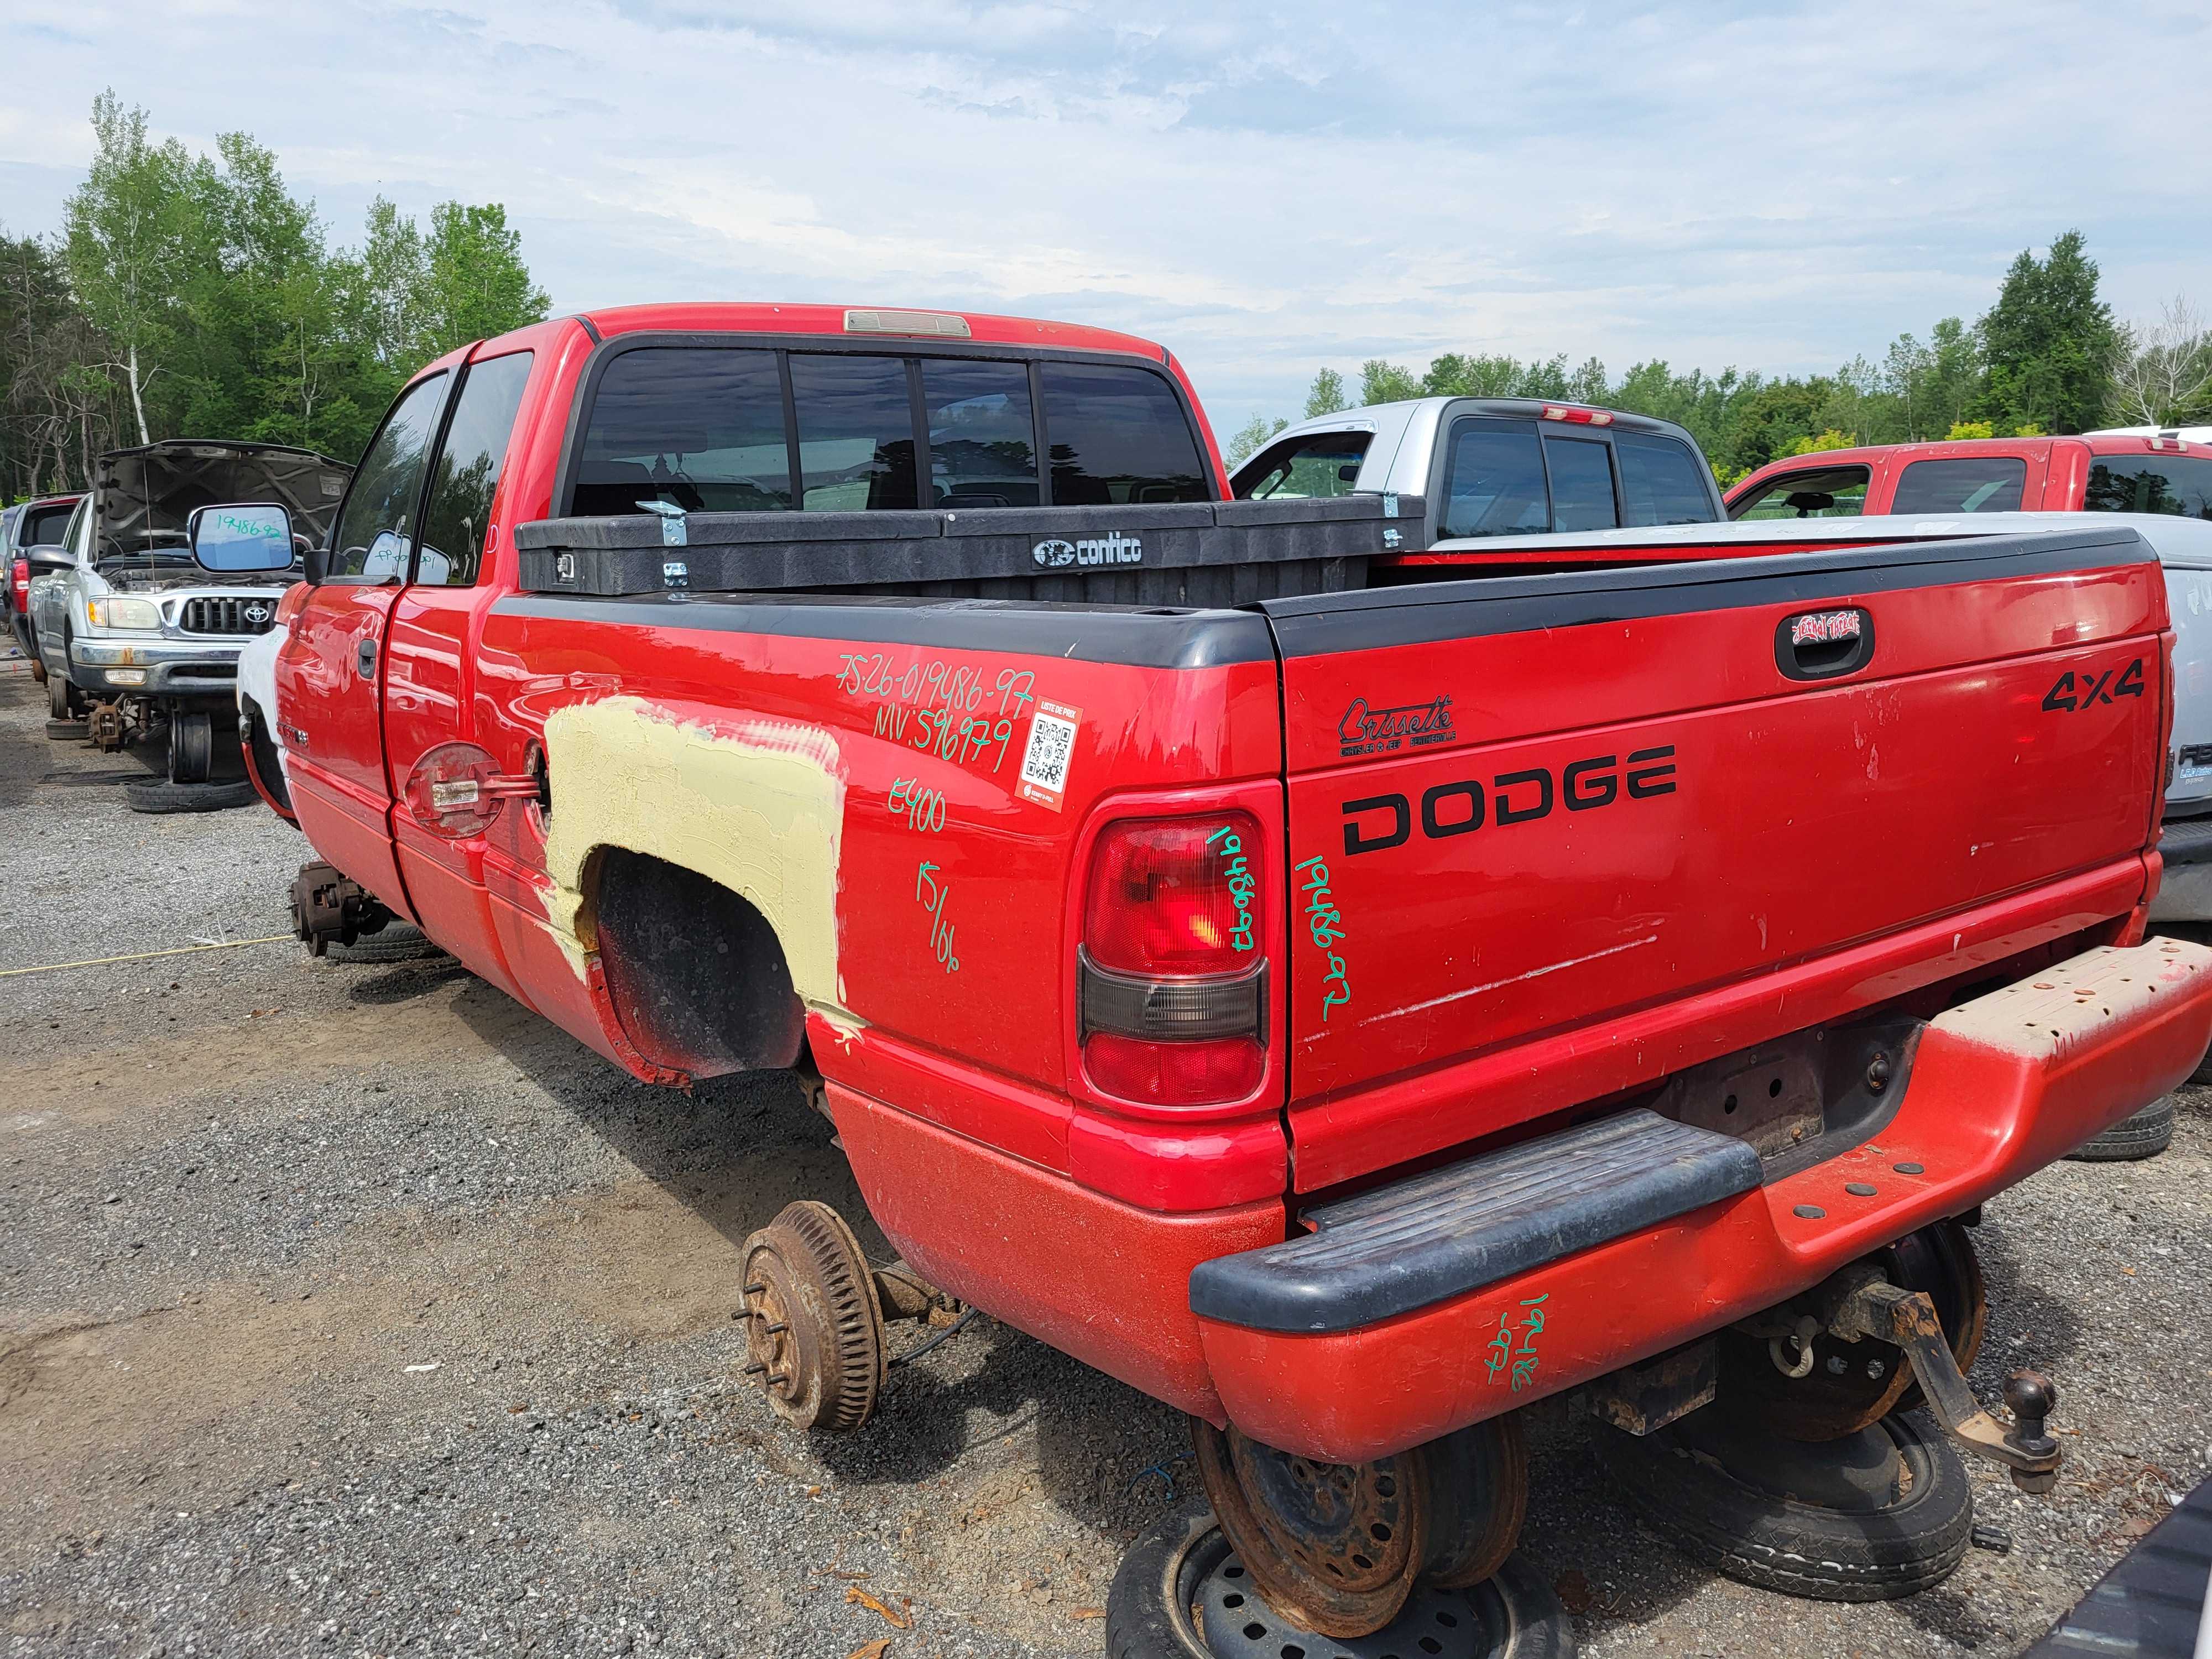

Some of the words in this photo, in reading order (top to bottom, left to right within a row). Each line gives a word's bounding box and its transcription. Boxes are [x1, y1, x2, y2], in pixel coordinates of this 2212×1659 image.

[1040, 701, 1056, 713] LISTE
[1055, 705, 1063, 715] DE
[1062, 707, 1077, 719] PRIX
[1340, 743, 1375, 757] CHRYSLER
[1386, 739, 1402, 750] JEEP
[1342, 744, 1677, 856] DODGE
